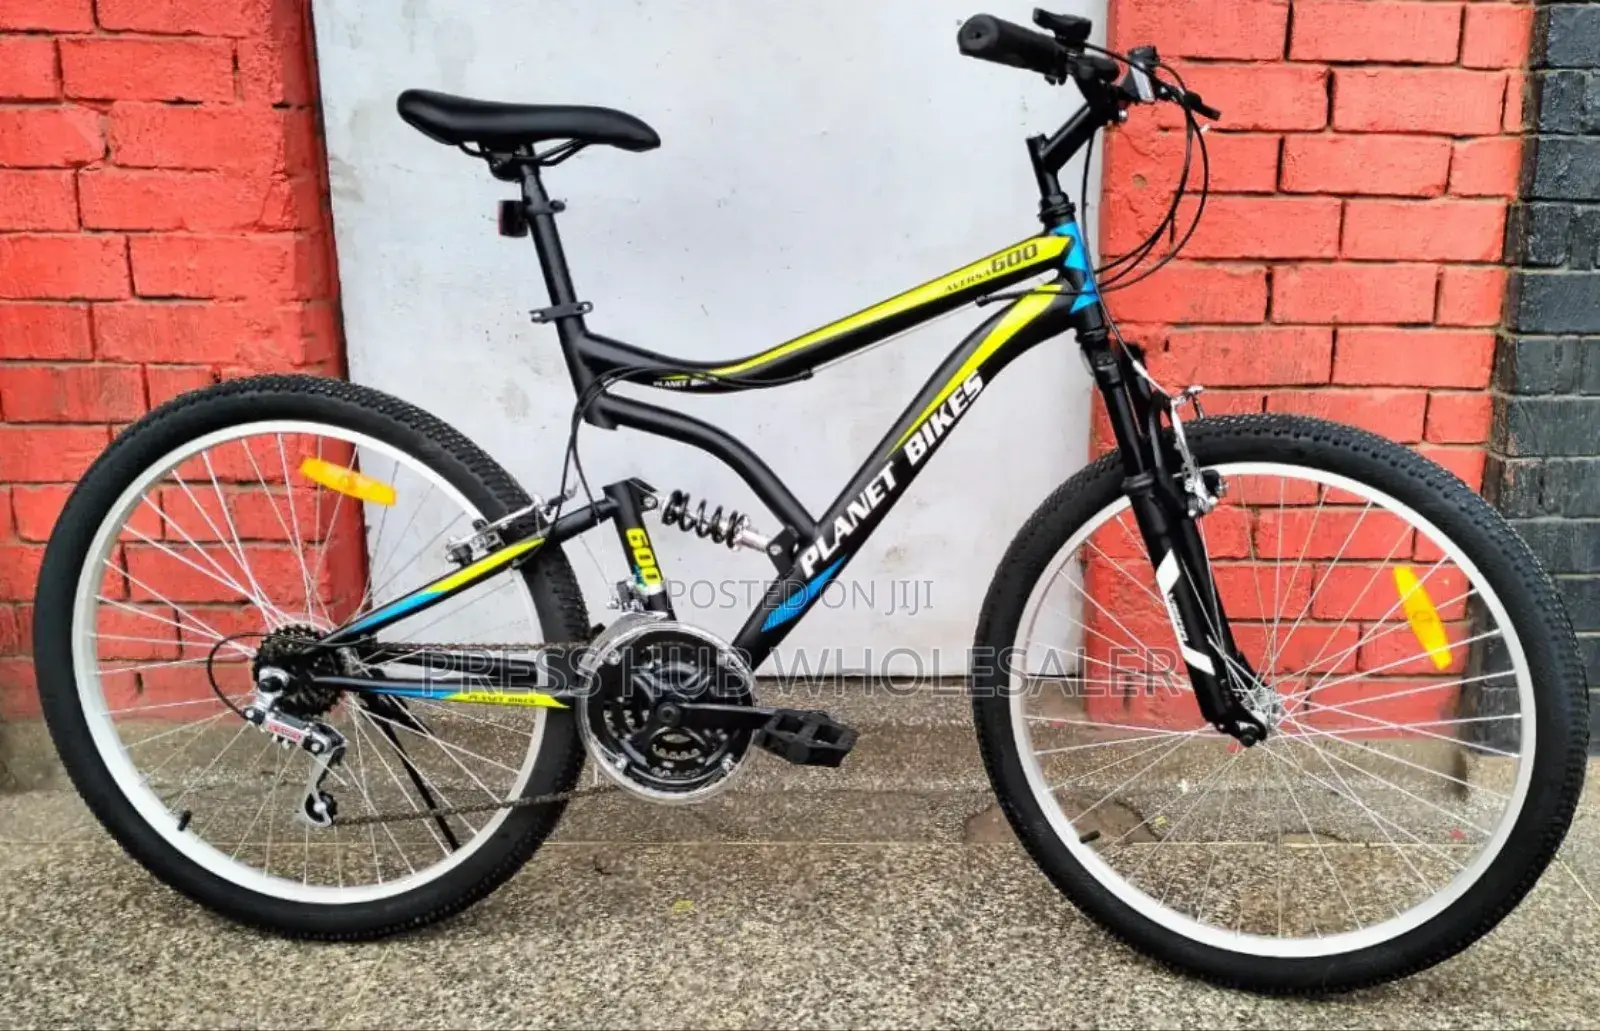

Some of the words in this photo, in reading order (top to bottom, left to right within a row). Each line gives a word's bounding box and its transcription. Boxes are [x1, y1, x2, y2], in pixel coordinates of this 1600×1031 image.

[992, 244, 1038, 273] 600
[799, 461, 897, 578] PLANET
[903, 369, 984, 466] BIKES
[626, 527, 662, 585] 600
